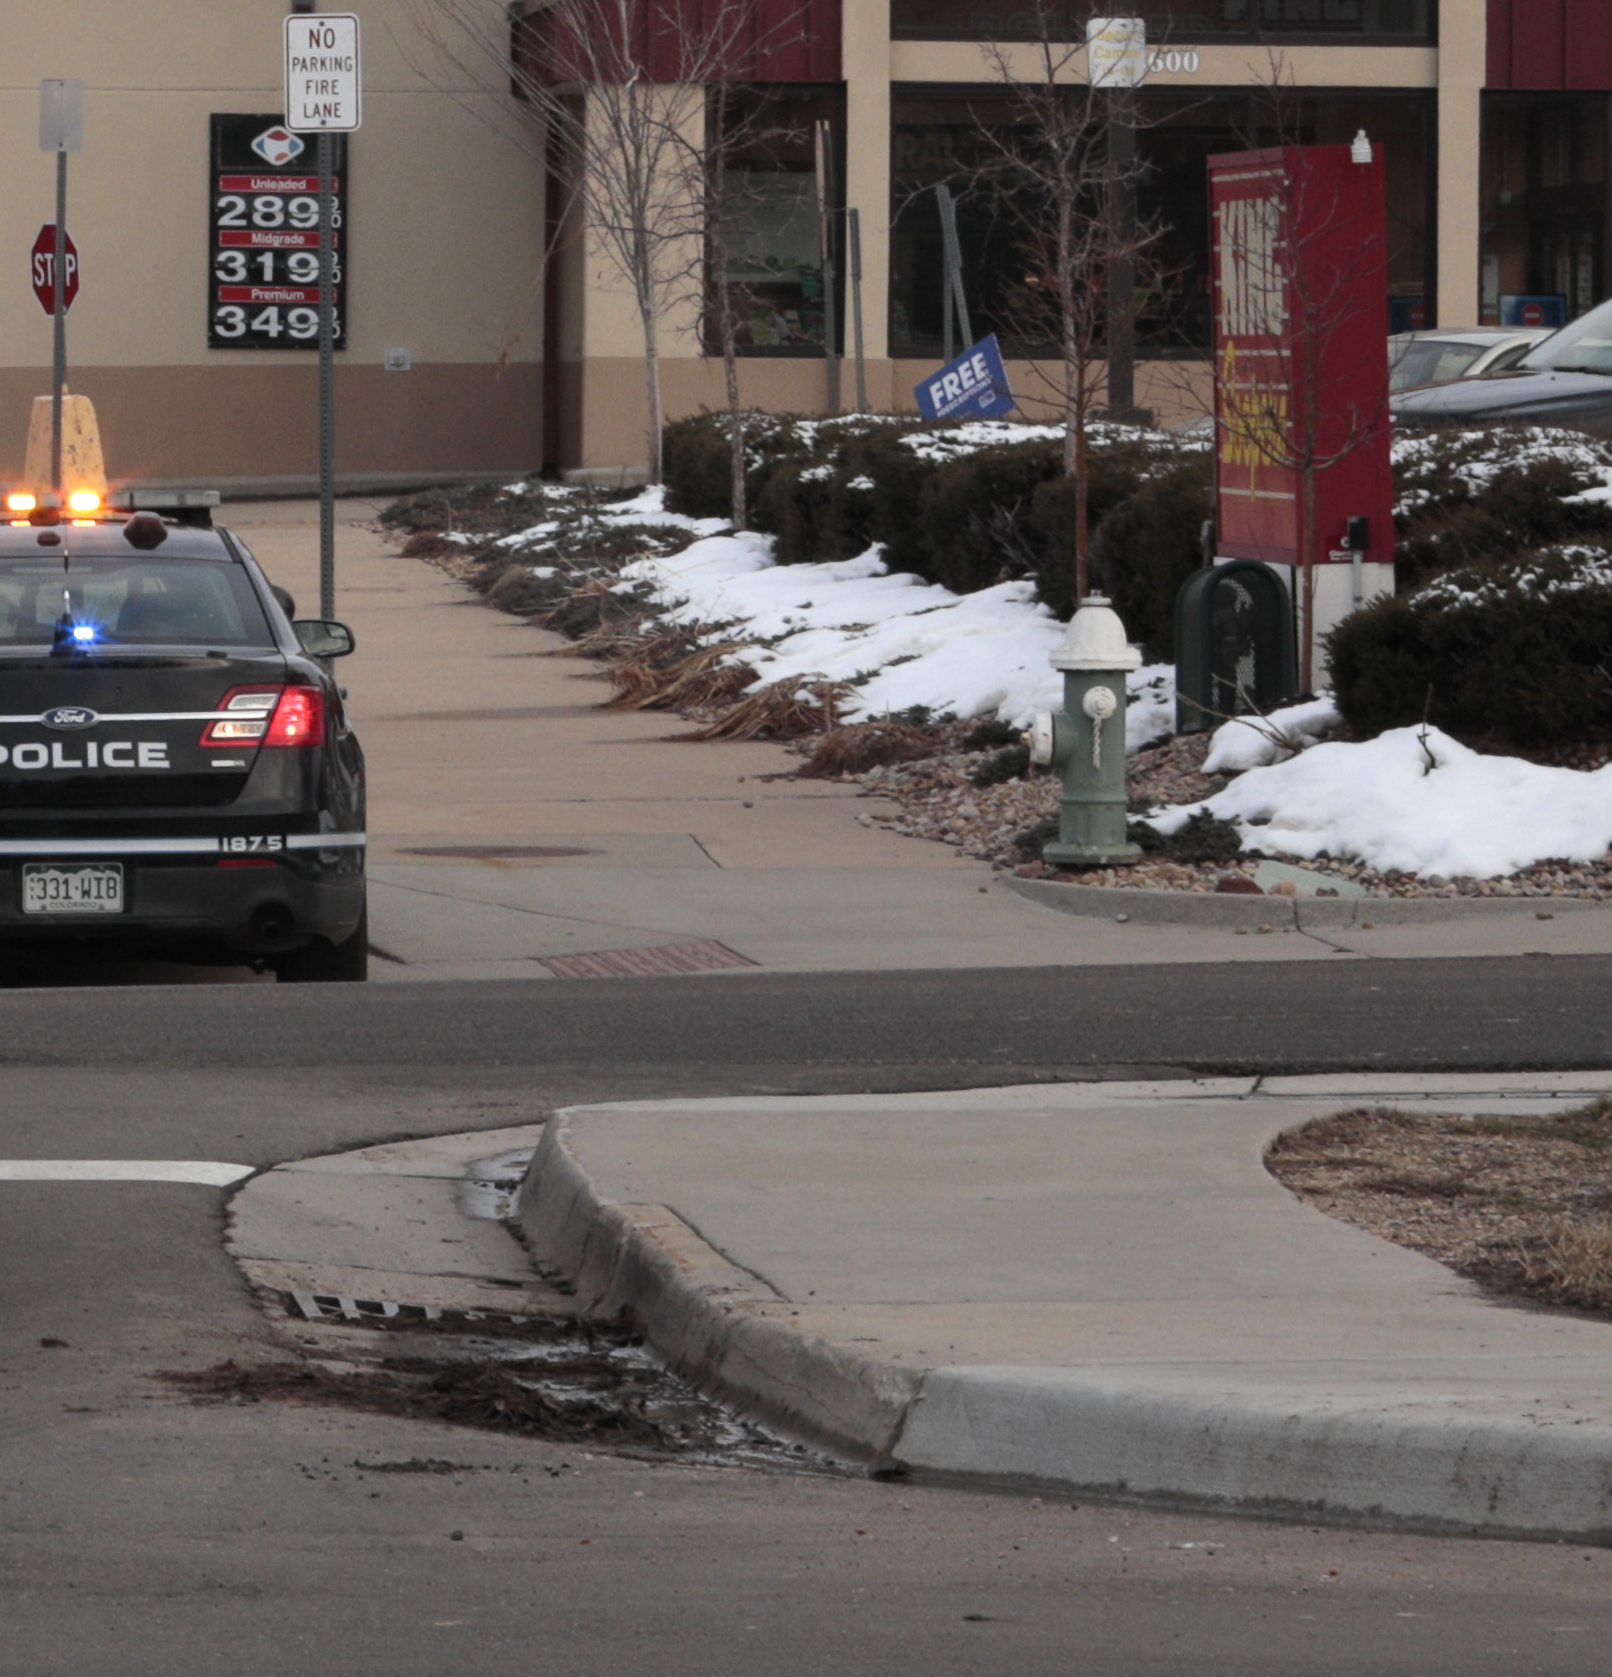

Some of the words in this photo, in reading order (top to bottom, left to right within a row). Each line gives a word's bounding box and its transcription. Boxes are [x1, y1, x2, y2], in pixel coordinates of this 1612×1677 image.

[309, 28, 336, 50] NO
[291, 56, 354, 74] PARKING
[1147, 51, 1200, 73] 600
[306, 79, 340, 97] FIRE
[303, 102, 343, 120] LANE
[251, 177, 307, 192] Unleaded
[216, 195, 320, 229] 289
[251, 232, 305, 248] Midgrade
[34, 253, 76, 287] STP
[215, 251, 320, 284] 319
[251, 287, 305, 302] Premium
[214, 305, 320, 339] 349
[929, 352, 987, 410] FREE
[53, 709, 86, 724] Ford
[222, 835, 283, 852] 1875
